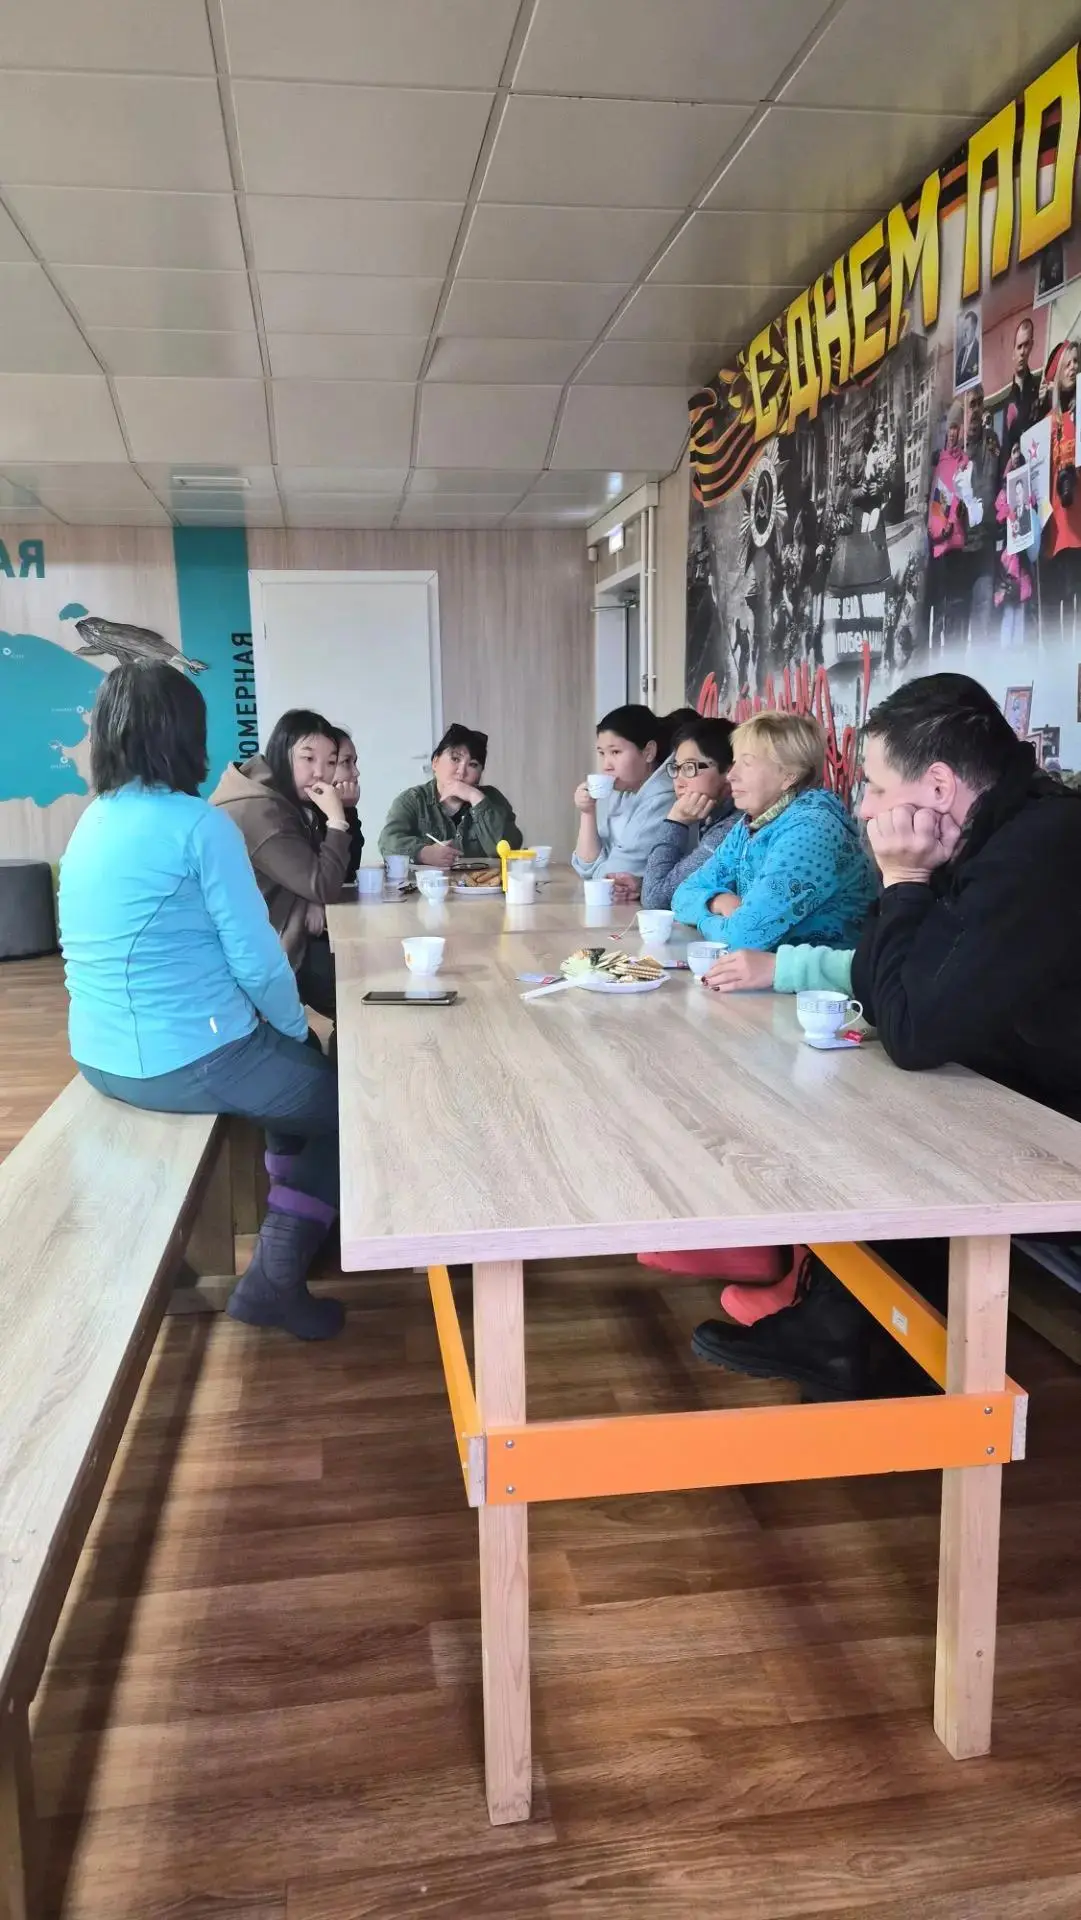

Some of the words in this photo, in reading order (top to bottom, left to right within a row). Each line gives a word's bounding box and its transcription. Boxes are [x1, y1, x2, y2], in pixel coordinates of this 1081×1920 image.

[786, 168, 941, 435] ДНЕМ
[962, 42, 1080, 299] ПО
[231, 631, 260, 771] ЮМЕРНАЯ
